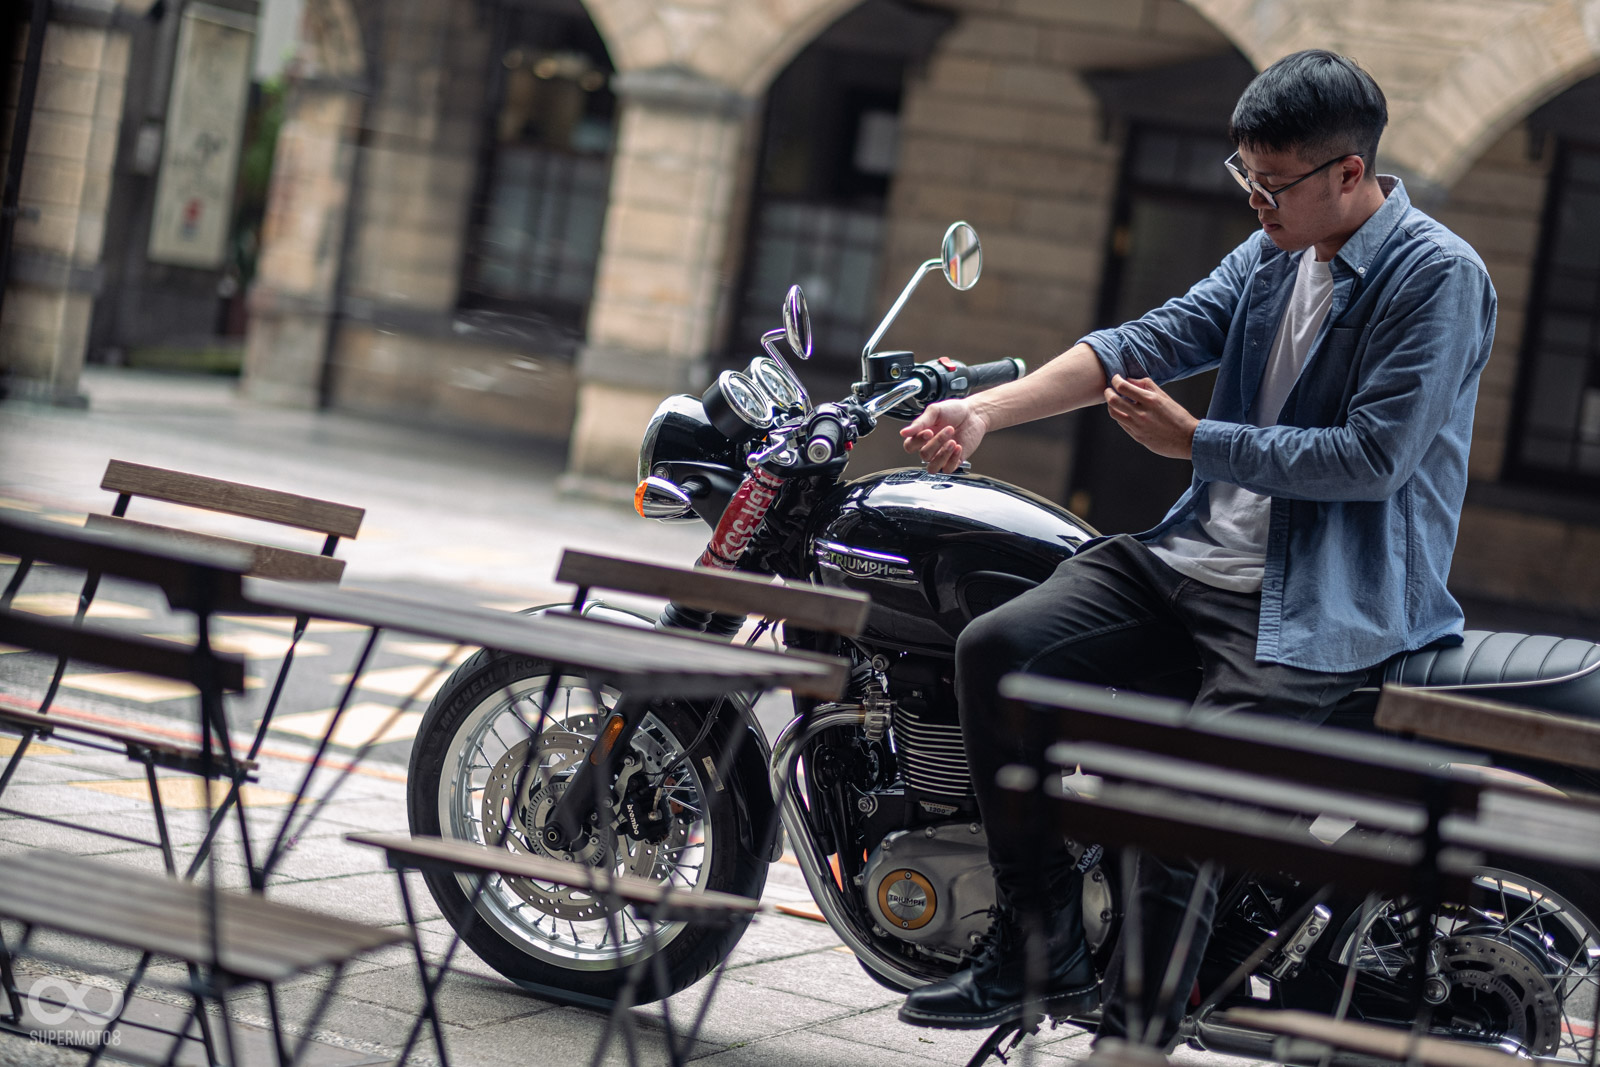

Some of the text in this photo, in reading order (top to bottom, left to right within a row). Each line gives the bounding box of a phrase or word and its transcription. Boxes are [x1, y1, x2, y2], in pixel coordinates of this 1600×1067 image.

[829, 551, 888, 576] TRIUMPH
[626, 803, 639, 835] brembo
[889, 894, 925, 906] TRIUMPH
